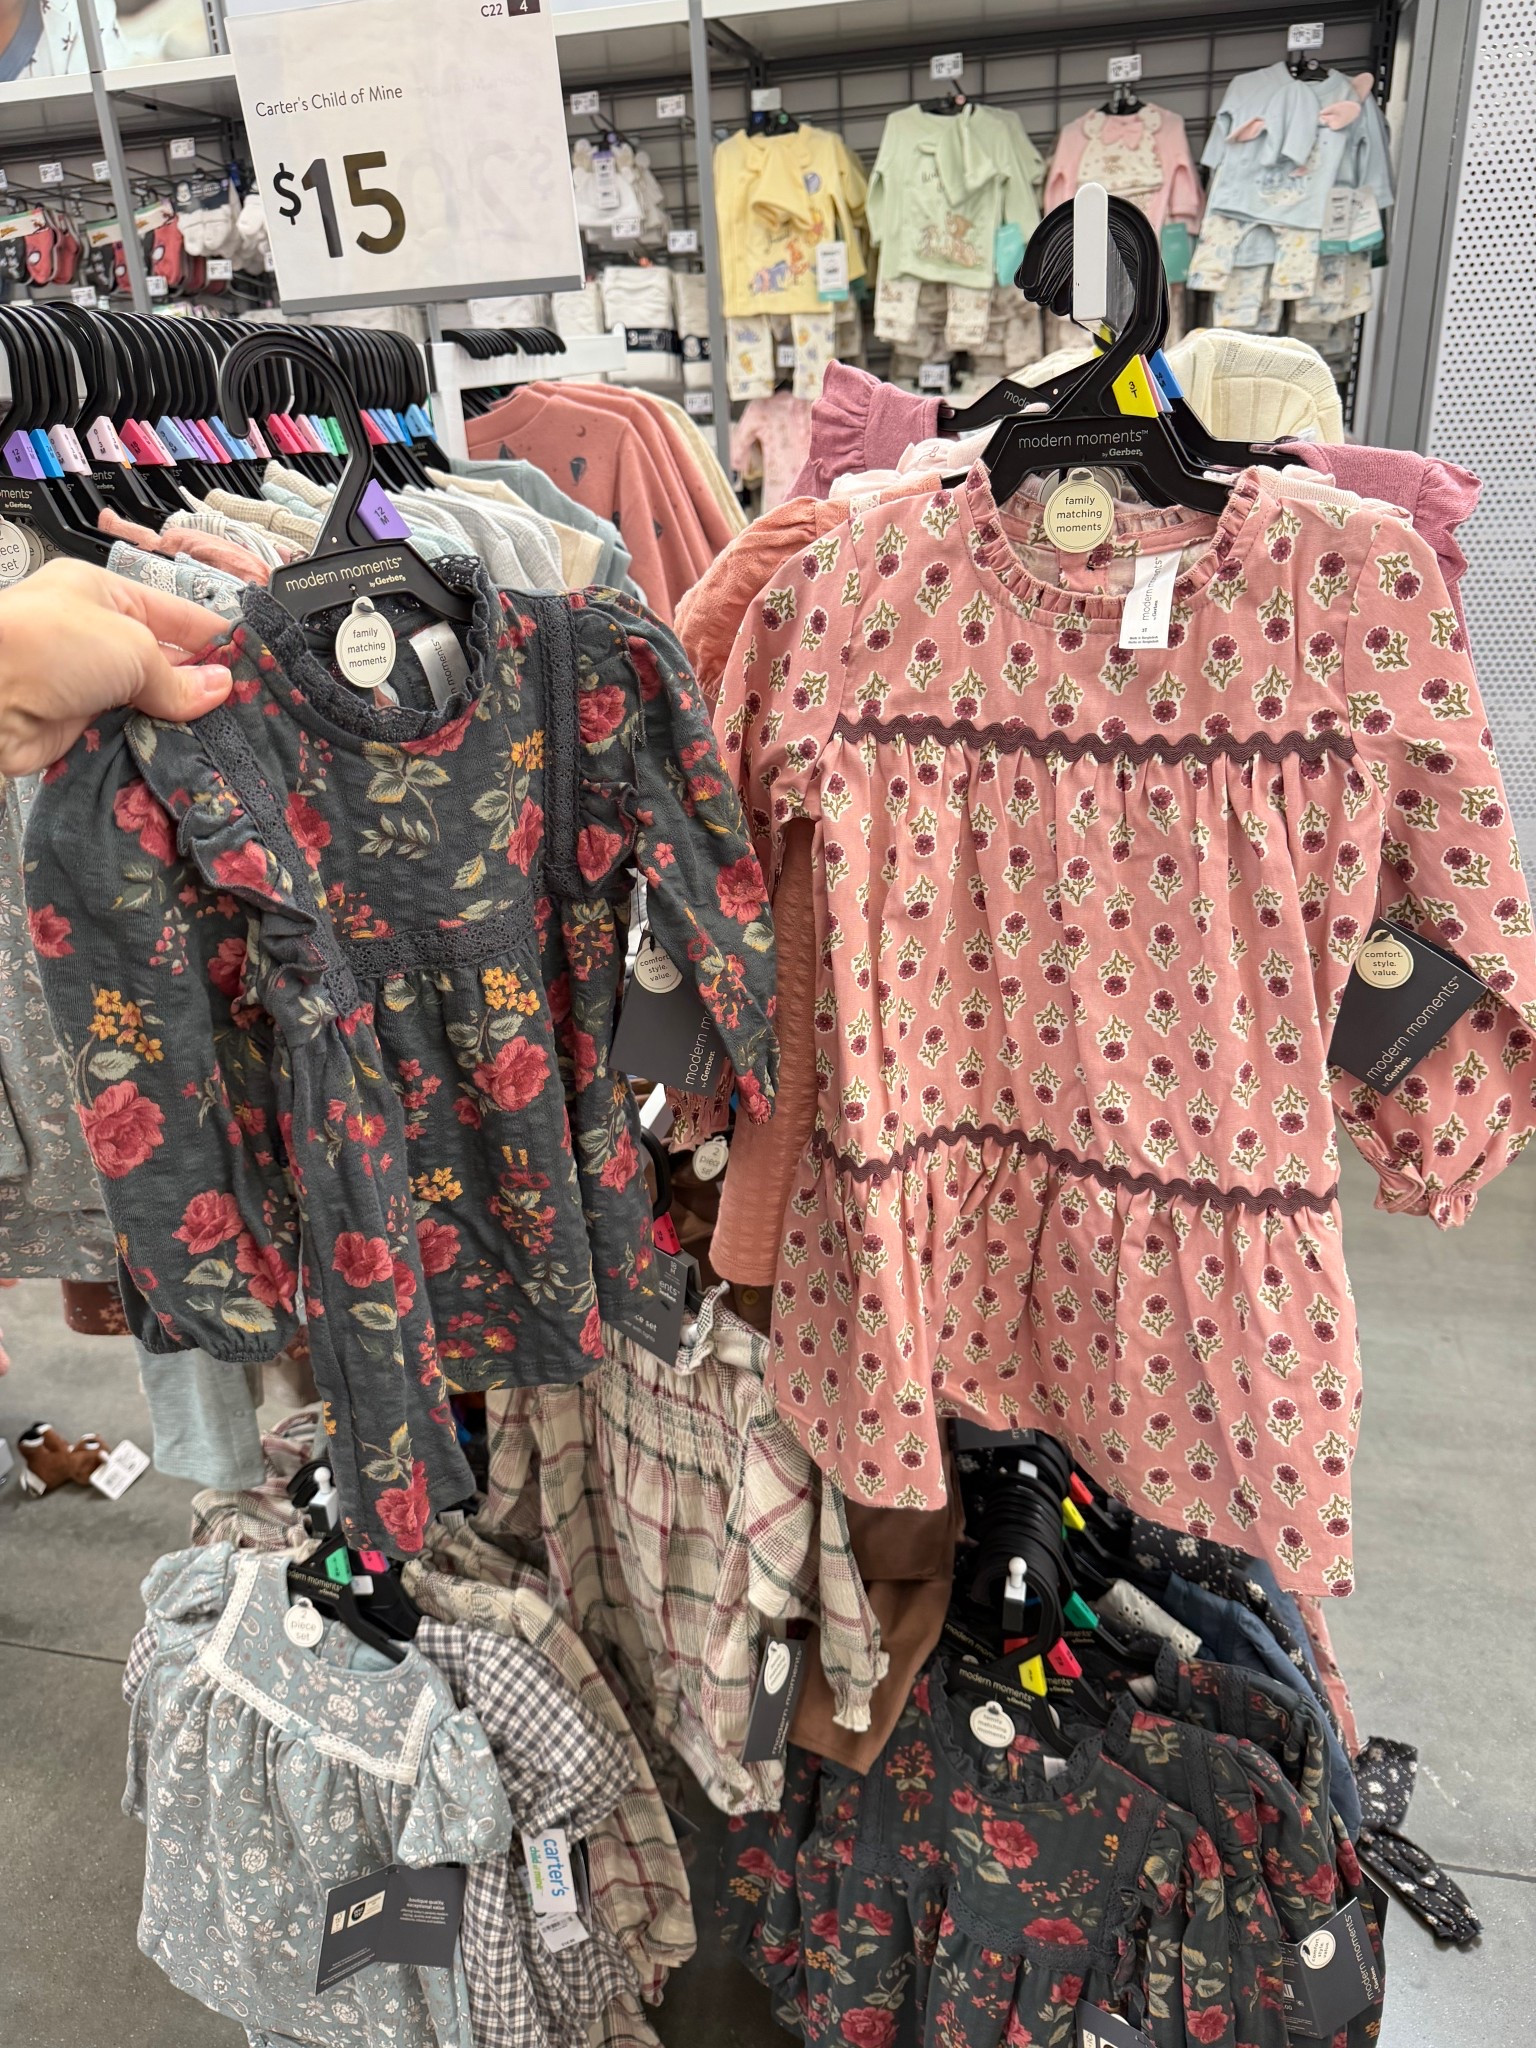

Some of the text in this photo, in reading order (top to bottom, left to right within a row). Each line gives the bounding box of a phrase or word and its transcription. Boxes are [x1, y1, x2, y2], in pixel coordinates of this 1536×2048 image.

[481, 0, 529, 17] C22 4
[255, 97, 309, 118] Carter's
[311, 91, 347, 110] Child
[350, 88, 365, 105] of
[369, 86, 403, 102] Mine
[273, 151, 406, 258] $15
[1129, 381, 1136, 390] 3
[1004, 390, 1031, 408] mode
[1131, 389, 1137, 398] T
[1018, 433, 1071, 449] modern
[93, 470, 113, 480] ents
[0, 488, 30, 499] ments
[1065, 496, 1095, 507] family
[374, 506, 386, 518] 12
[1056, 509, 1102, 520] matching
[379, 515, 390, 525] M
[1056, 523, 1102, 533] moments
[0, 544, 19, 555] ece
[1, 558, 19, 572] set
[285, 571, 338, 592] modern
[1142, 588, 1153, 621] modern
[353, 627, 378, 639] family
[347, 641, 386, 654] matching
[349, 655, 387, 668] moments
[1365, 950, 1403, 958] comfort.
[648, 964, 667, 974] style.
[650, 972, 671, 982] value.
[685, 1033, 707, 1085] modern
[1366, 1036, 1409, 1080] modern
[660, 1280, 678, 1296] ents
[959, 1668, 991, 1686] modern
[543, 1838, 570, 1897] carter's
[1360, 1962, 1374, 2000] modern
